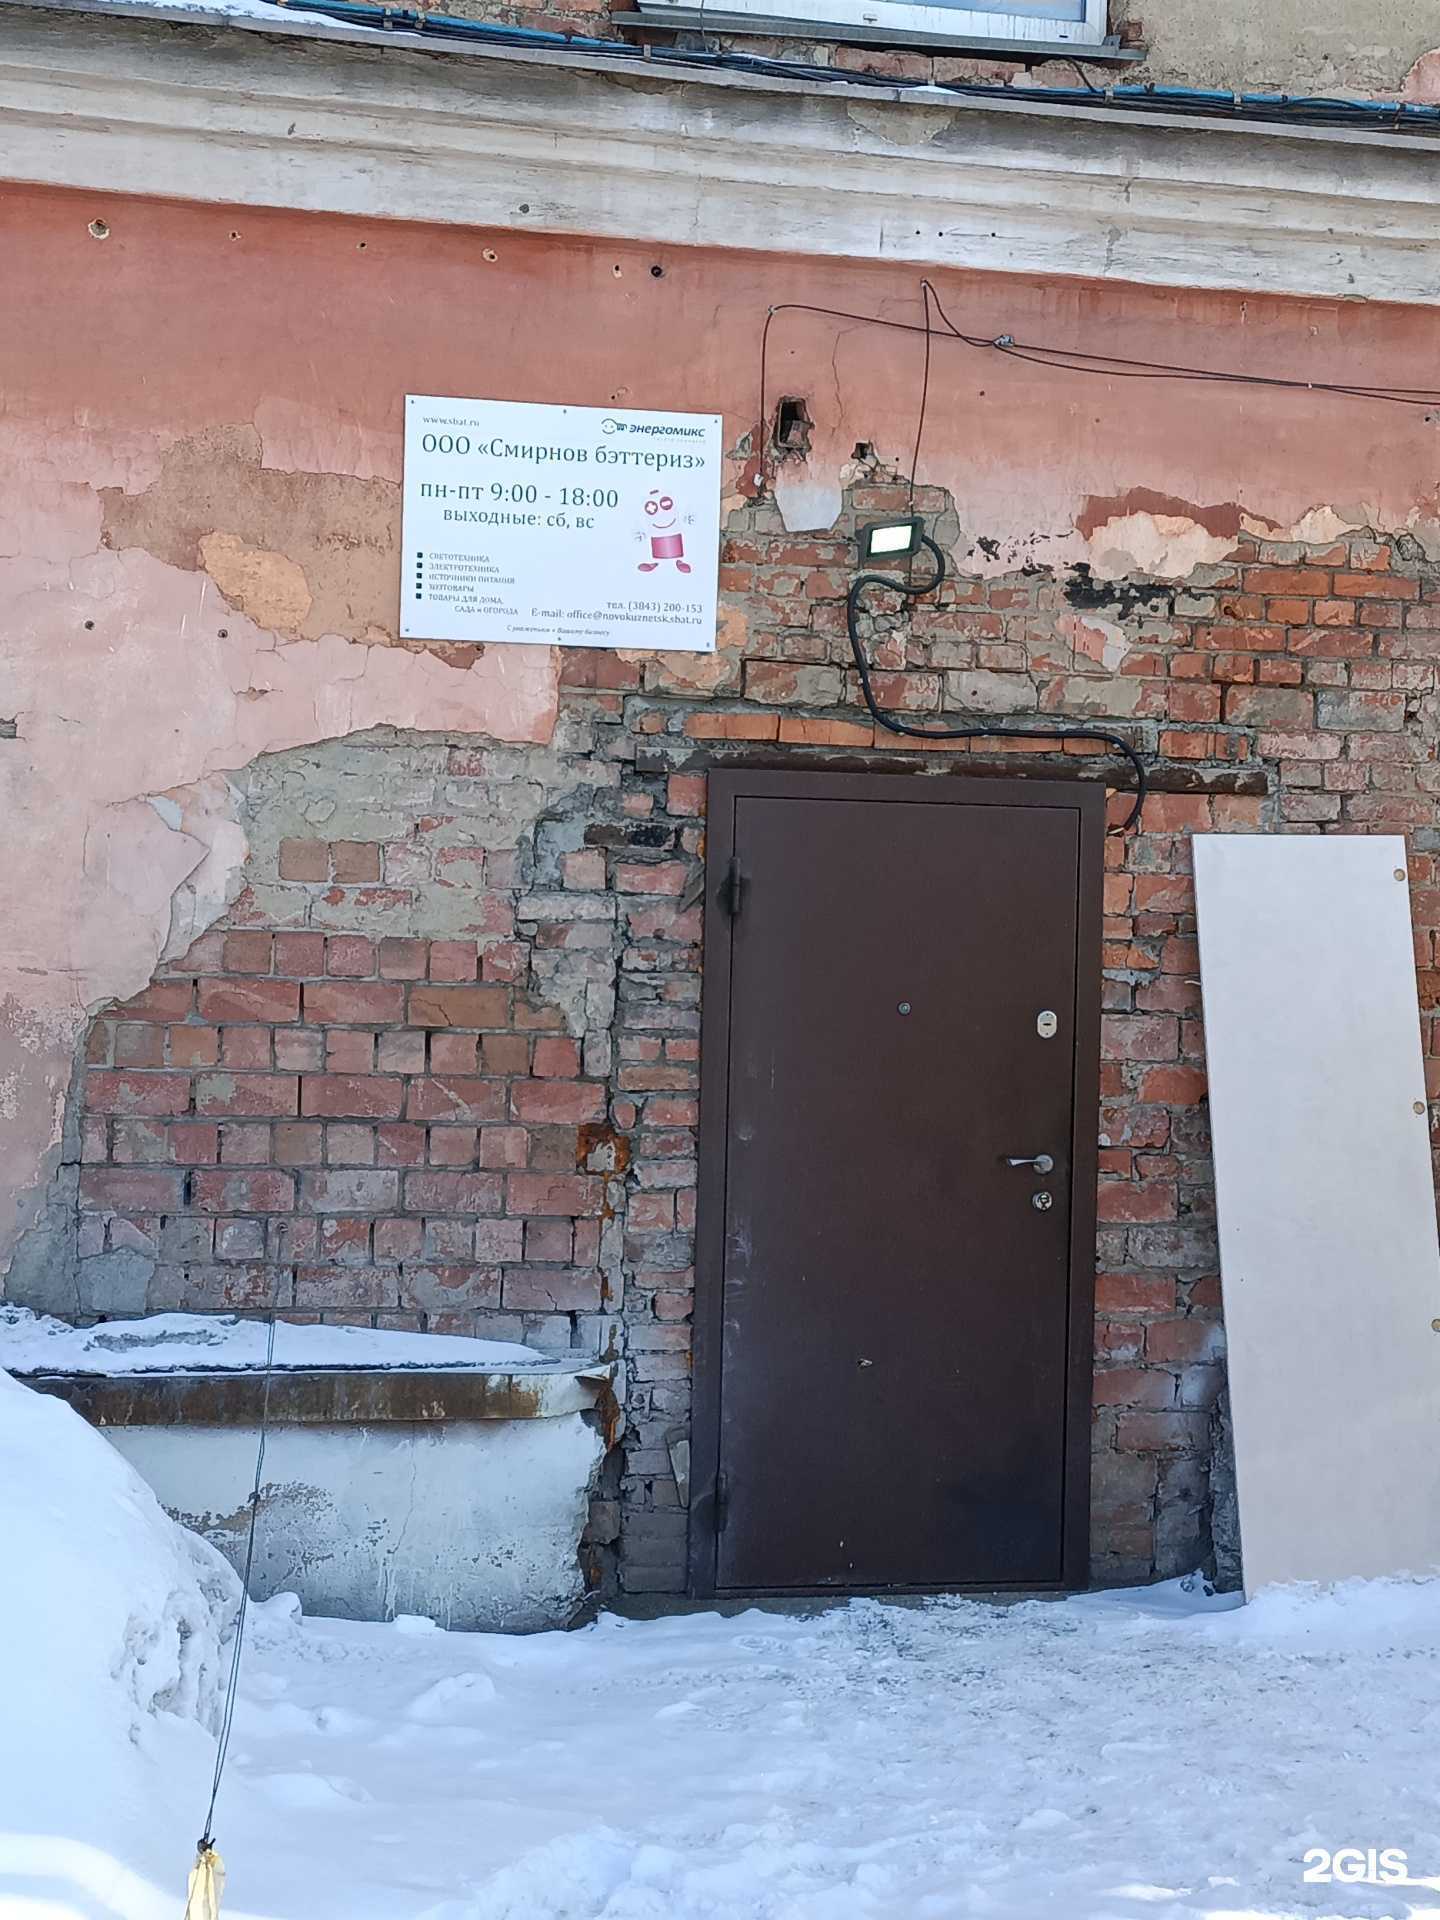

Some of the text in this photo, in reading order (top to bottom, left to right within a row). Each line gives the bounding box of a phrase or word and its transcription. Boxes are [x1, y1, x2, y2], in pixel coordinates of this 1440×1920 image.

[423, 416, 480, 427] www.sbat.ru
[629, 424, 706, 437] энергомикс
[422, 433, 705, 472] ООО «Смирнов бэттериз»
[421, 483, 484, 500] пн-пт
[491, 482, 537, 503] 9:00
[559, 487, 619, 508] 18:00
[443, 509, 595, 529] выходные: сб, вс
[531, 607, 565, 619] E-mail:
[606, 601, 703, 614] тел. (3843) 200-153
